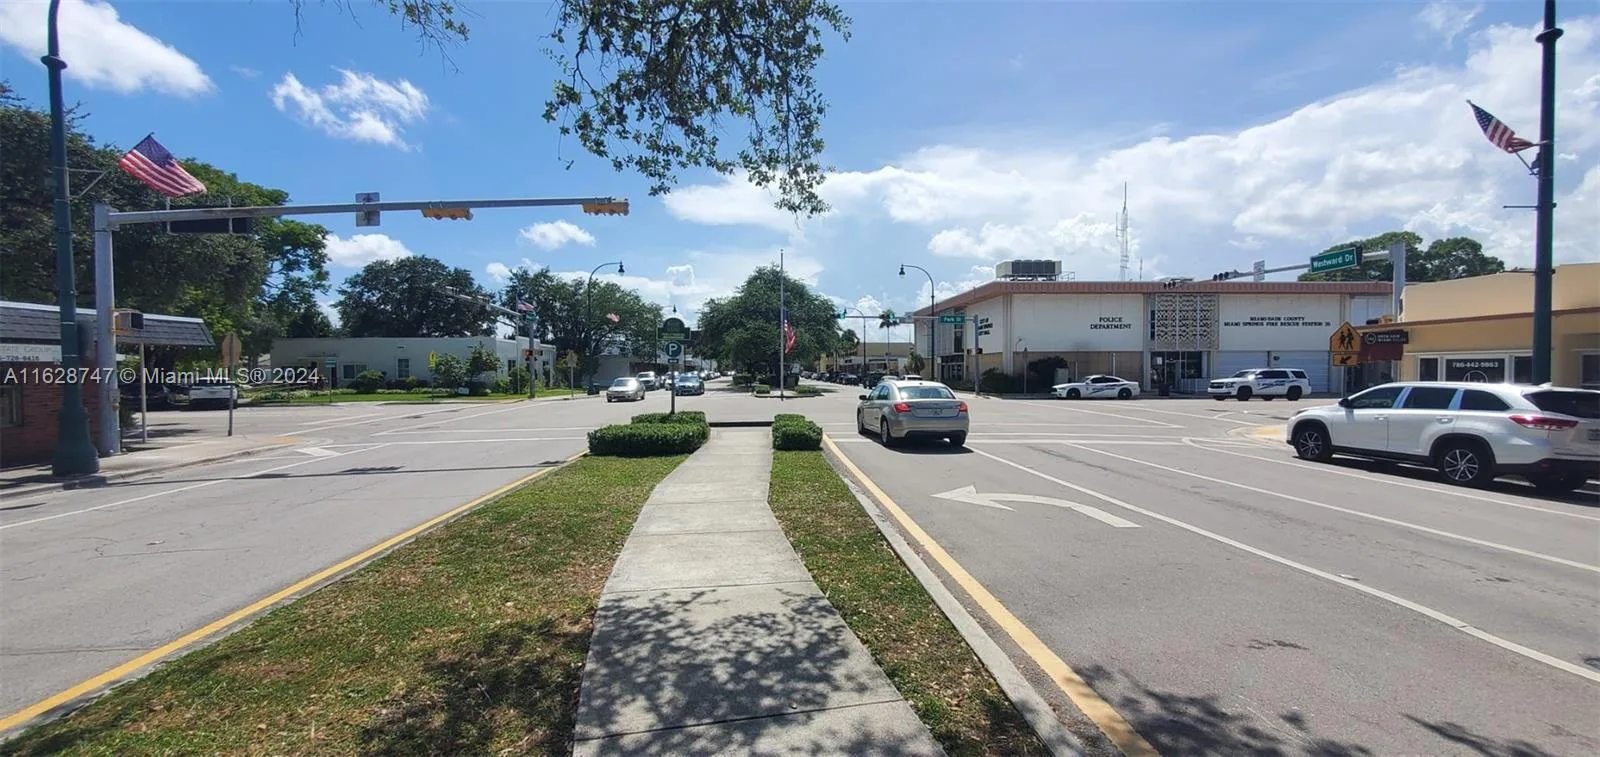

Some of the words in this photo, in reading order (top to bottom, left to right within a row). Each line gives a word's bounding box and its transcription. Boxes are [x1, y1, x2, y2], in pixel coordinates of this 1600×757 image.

[1313, 256, 1343, 268] Westward
[1345, 254, 1353, 262] Dr
[669, 343, 678, 355] P
